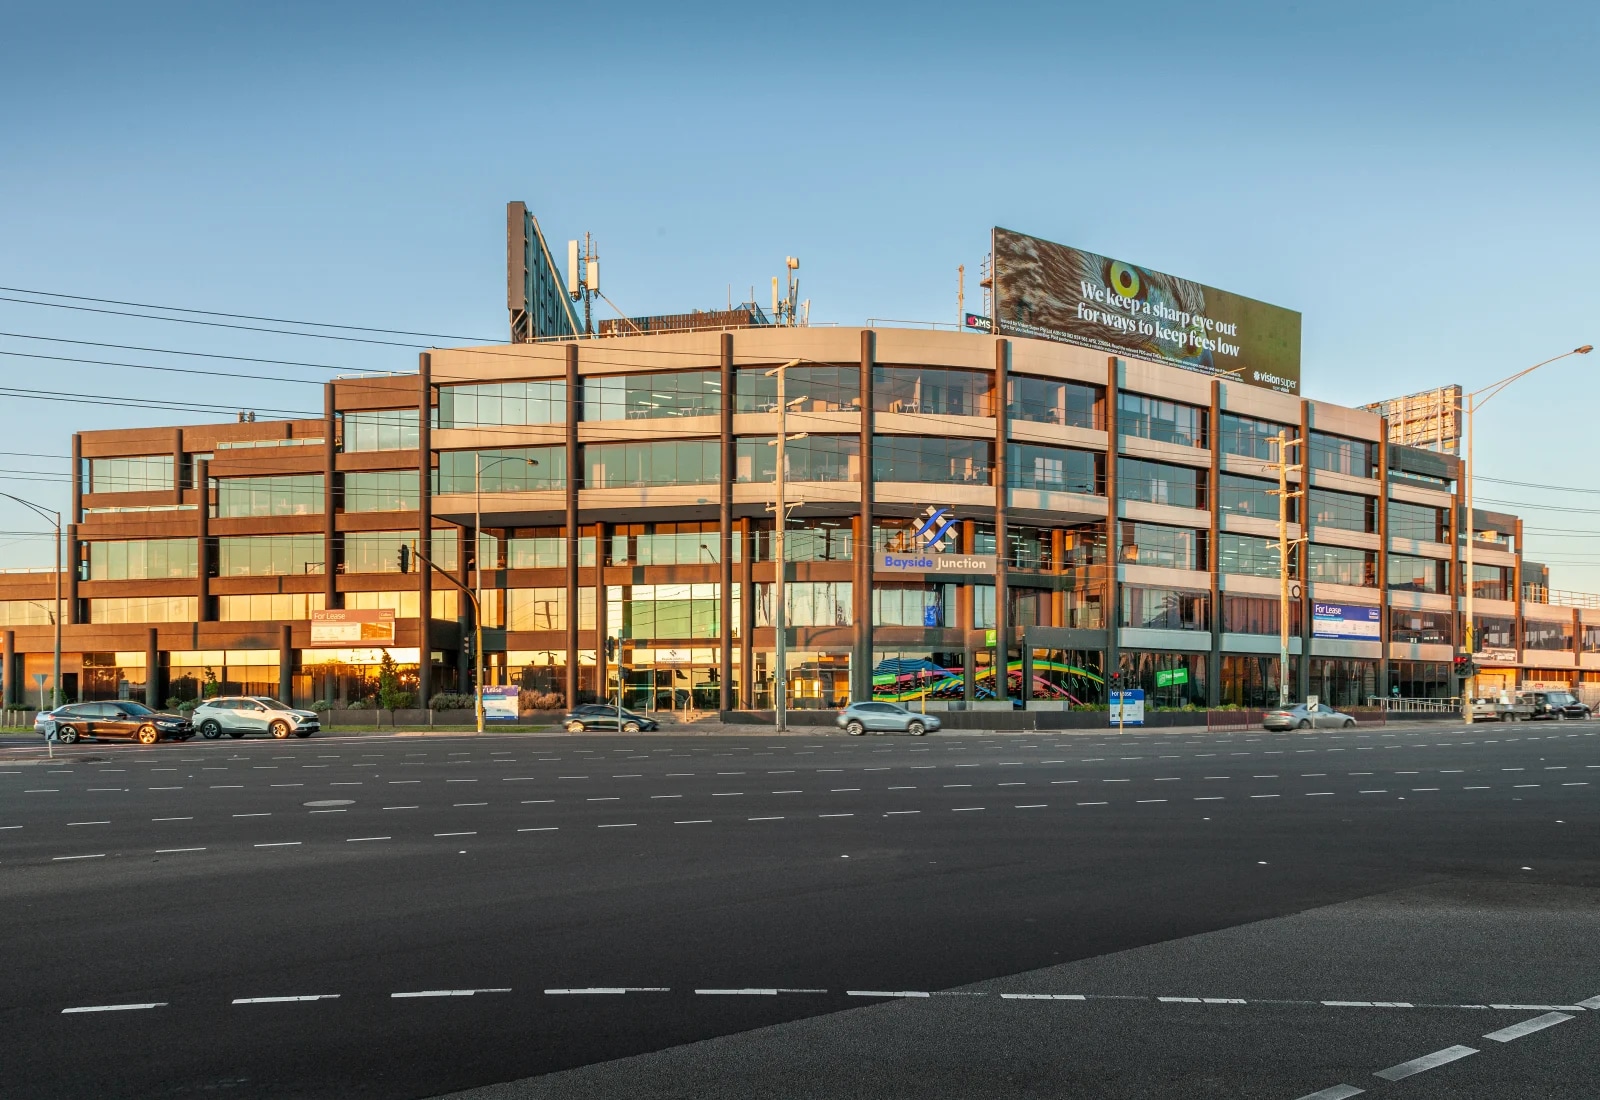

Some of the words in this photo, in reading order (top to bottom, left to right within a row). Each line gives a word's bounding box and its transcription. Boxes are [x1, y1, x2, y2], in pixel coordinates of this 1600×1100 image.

[1081, 281, 1104, 302] We
[1106, 288, 1140, 316] keep
[1143, 302, 1150, 314] a
[1153, 302, 1190, 328] sharp
[1192, 314, 1213, 332] eye
[1216, 321, 1237, 336] out
[1078, 302, 1100, 322] for
[1102, 313, 1136, 334] ways
[1138, 320, 1153, 336] to
[1156, 322, 1187, 348] keep
[1190, 330, 1216, 351] fees
[1218, 337, 1240, 356] low
[1260, 372, 1280, 384] vision
[1280, 378, 1297, 389] super
[885, 556, 933, 570] Bayside
[936, 557, 986, 570] Junction
[1316, 604, 1325, 612] For
[1326, 606, 1342, 614] Lease
